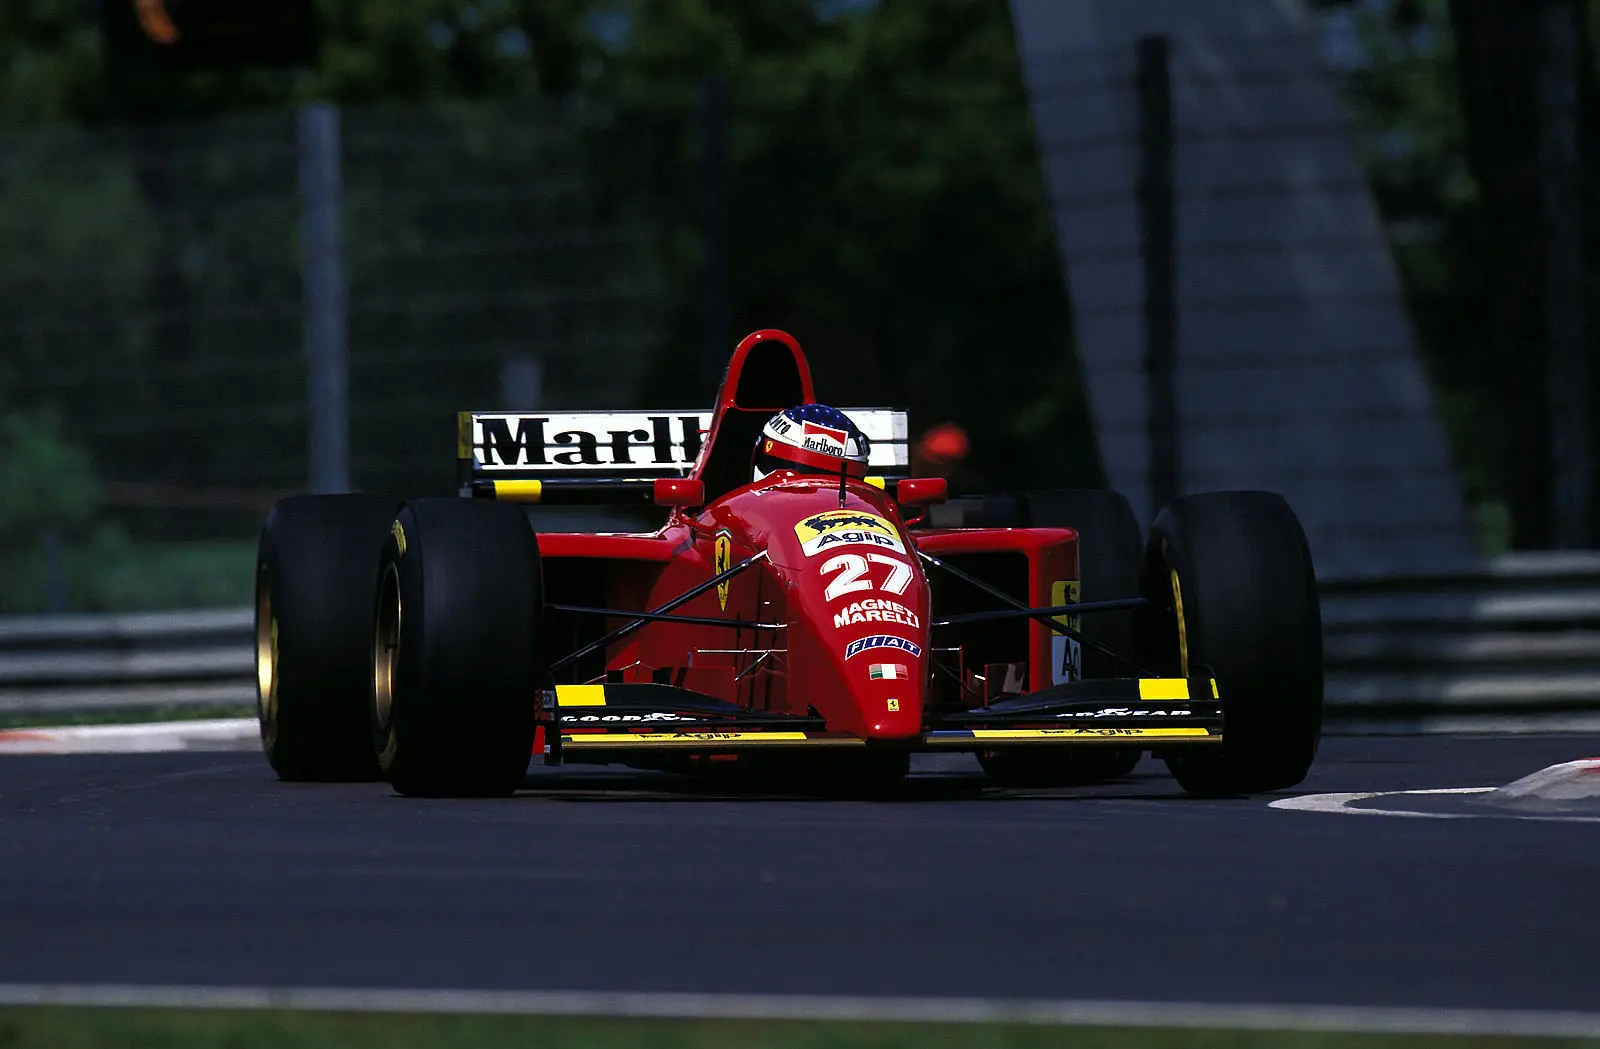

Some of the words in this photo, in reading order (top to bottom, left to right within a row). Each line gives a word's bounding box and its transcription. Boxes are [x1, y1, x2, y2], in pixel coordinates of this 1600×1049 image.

[802, 436, 843, 456] Marlboro
[817, 531, 895, 549] Agip
[819, 553, 913, 602] 27
[847, 636, 919, 656] FIAT
